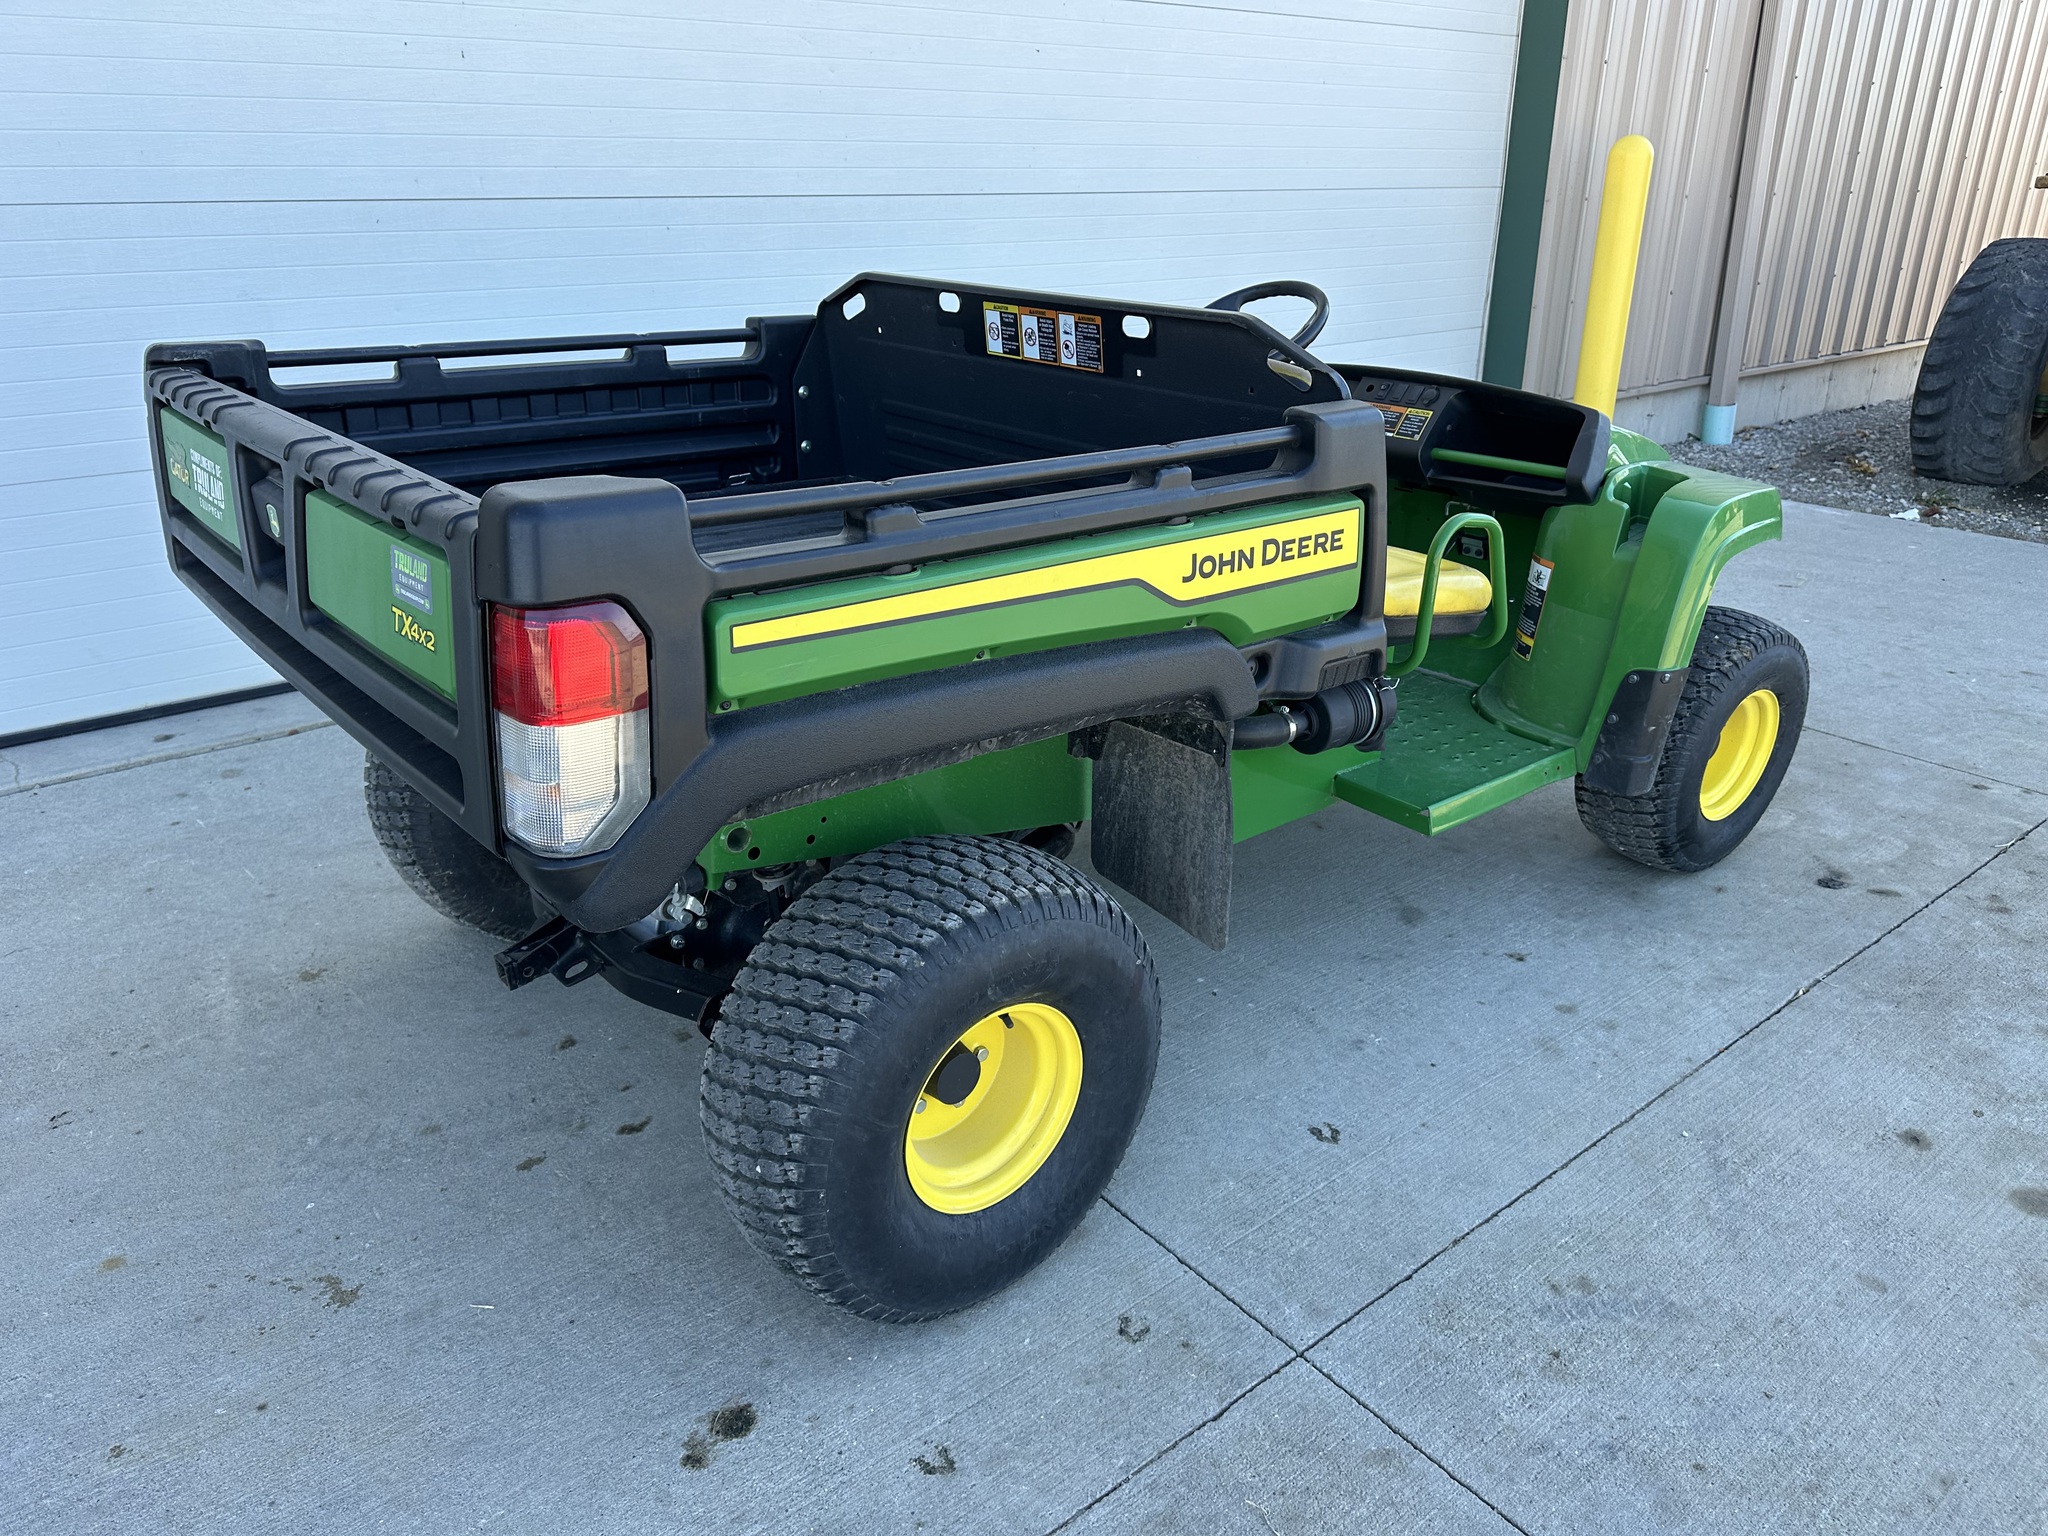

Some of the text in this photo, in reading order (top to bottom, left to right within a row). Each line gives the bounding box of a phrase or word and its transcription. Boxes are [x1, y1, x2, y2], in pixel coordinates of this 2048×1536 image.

[192, 462, 225, 510] TRULAND
[393, 548, 429, 583] TRULAND
[1182, 528, 1345, 583] JOHN DEERE
